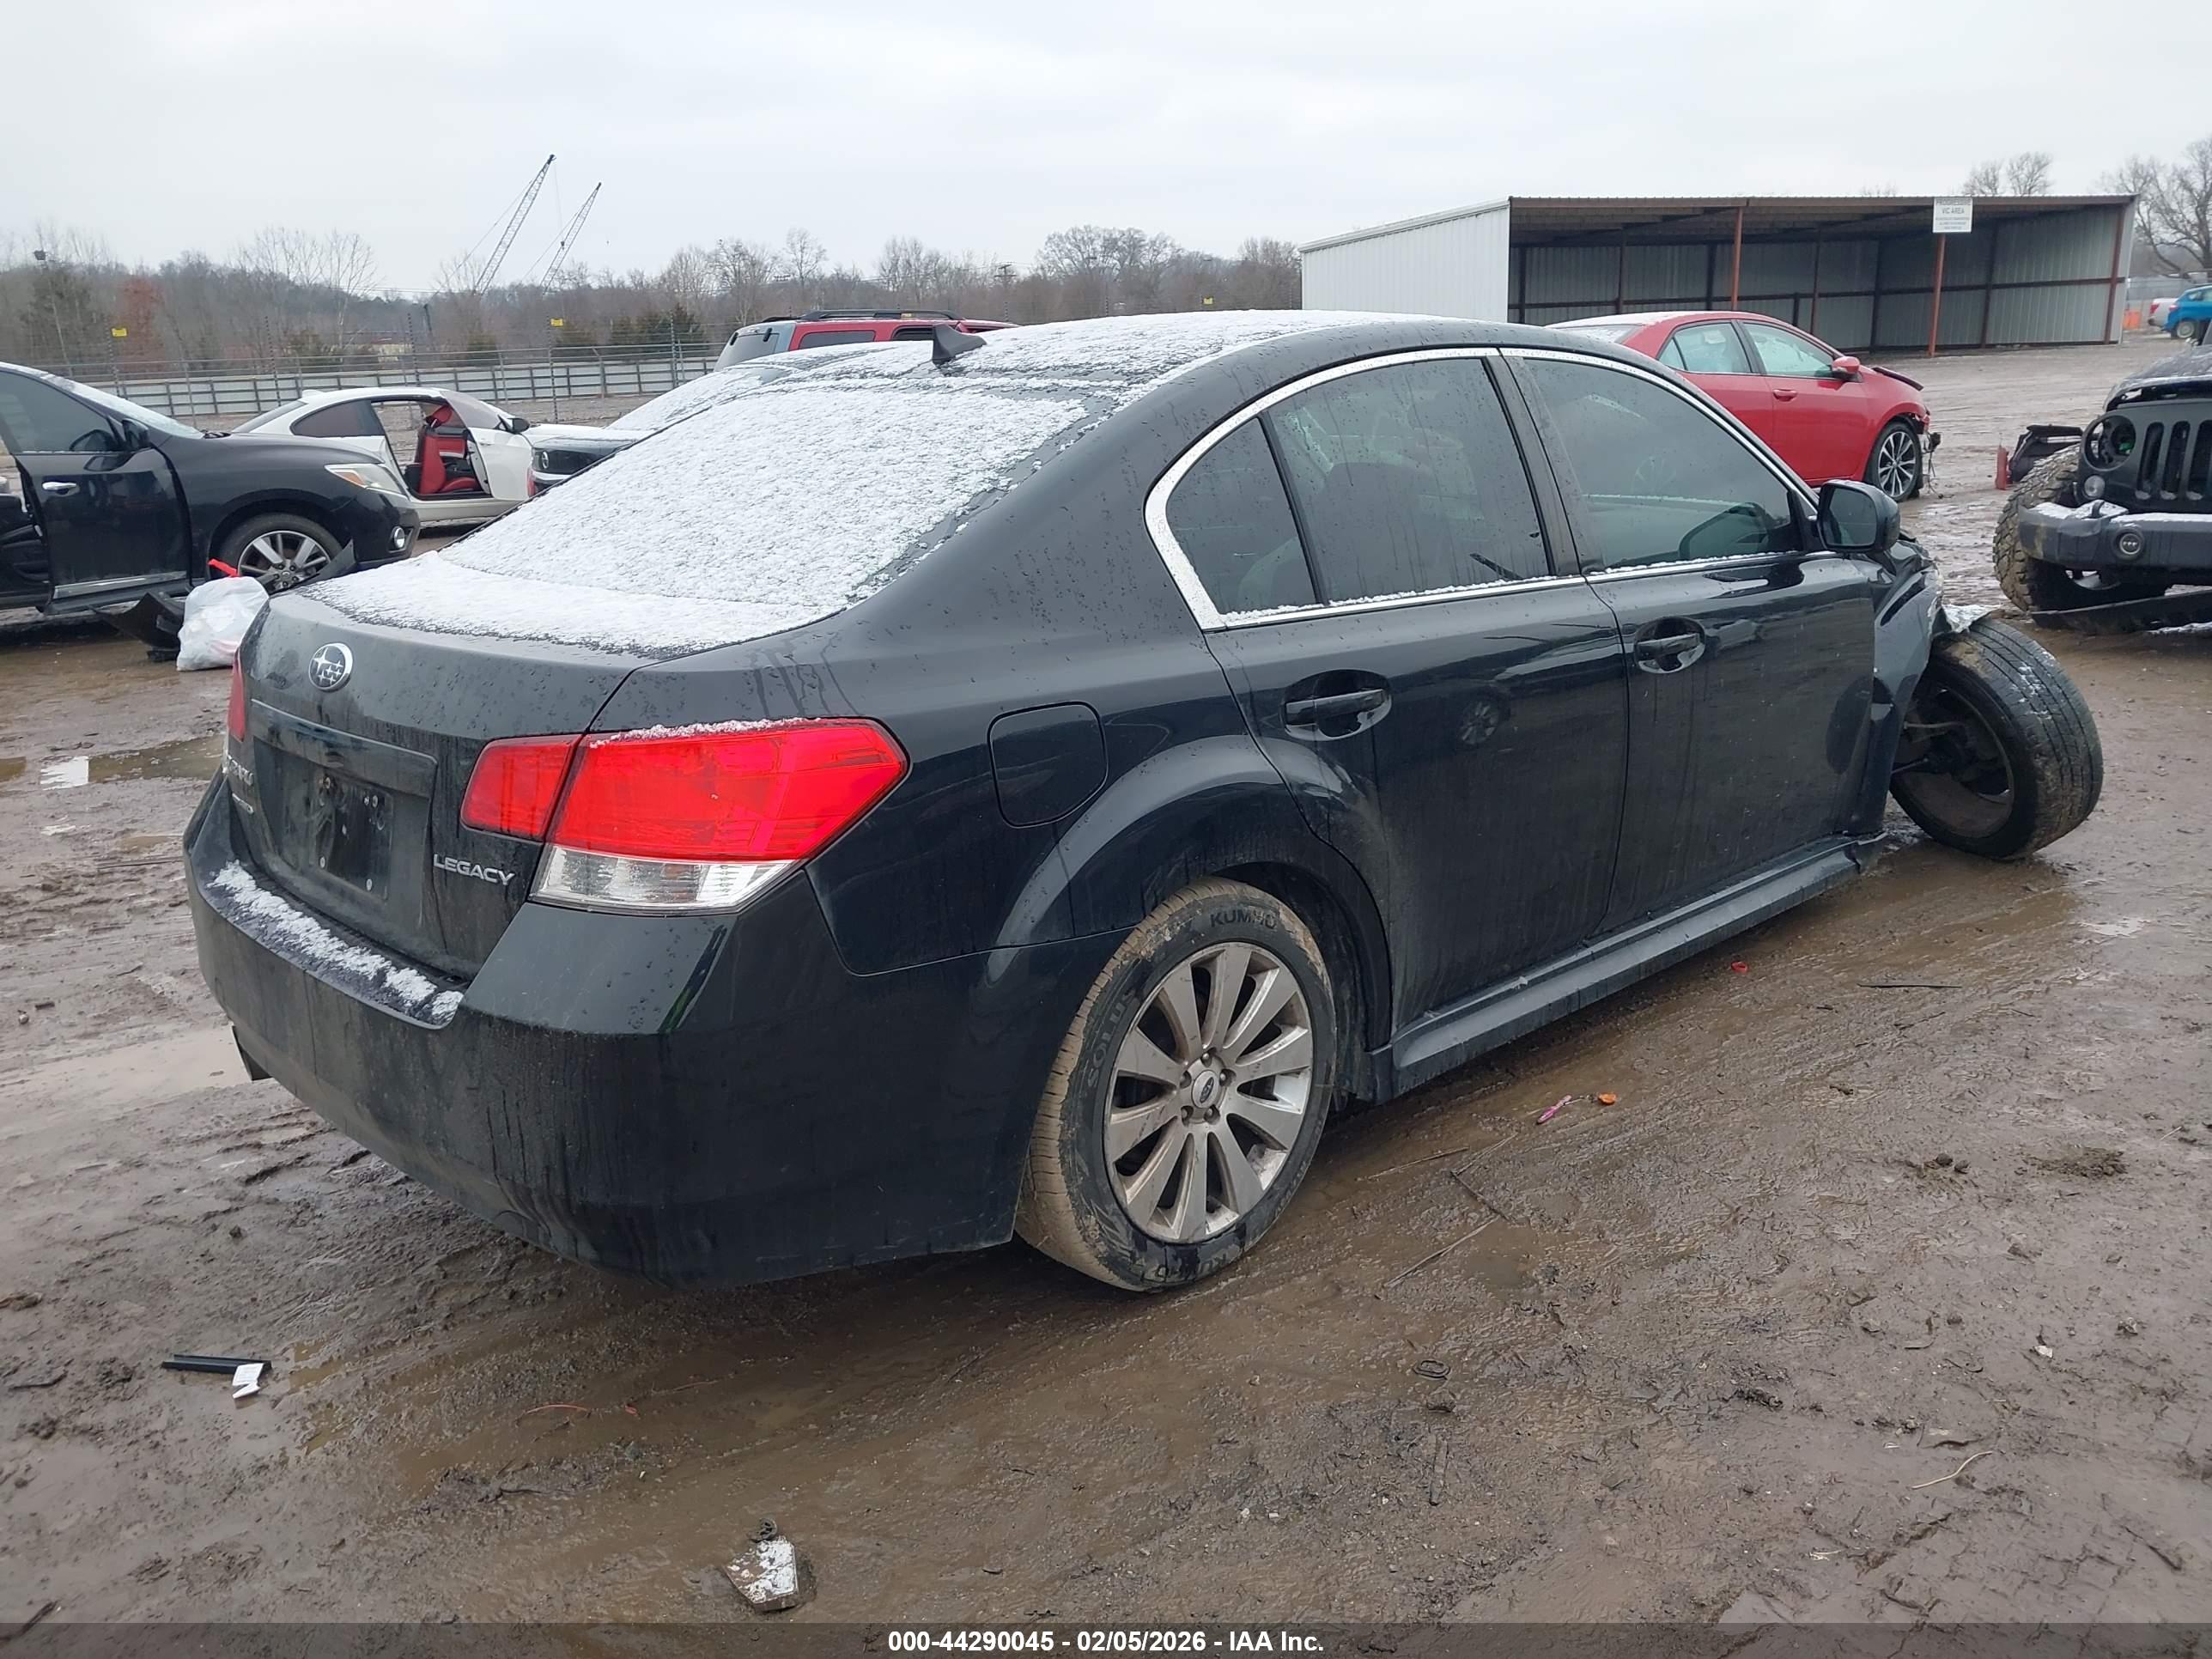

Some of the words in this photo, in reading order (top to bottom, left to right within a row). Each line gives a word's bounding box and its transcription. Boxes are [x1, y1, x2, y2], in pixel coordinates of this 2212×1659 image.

[434, 854, 515, 885] LEGACY
[1210, 908, 1278, 929] KUMHO
[1087, 988, 1136, 1088] SOLUS
